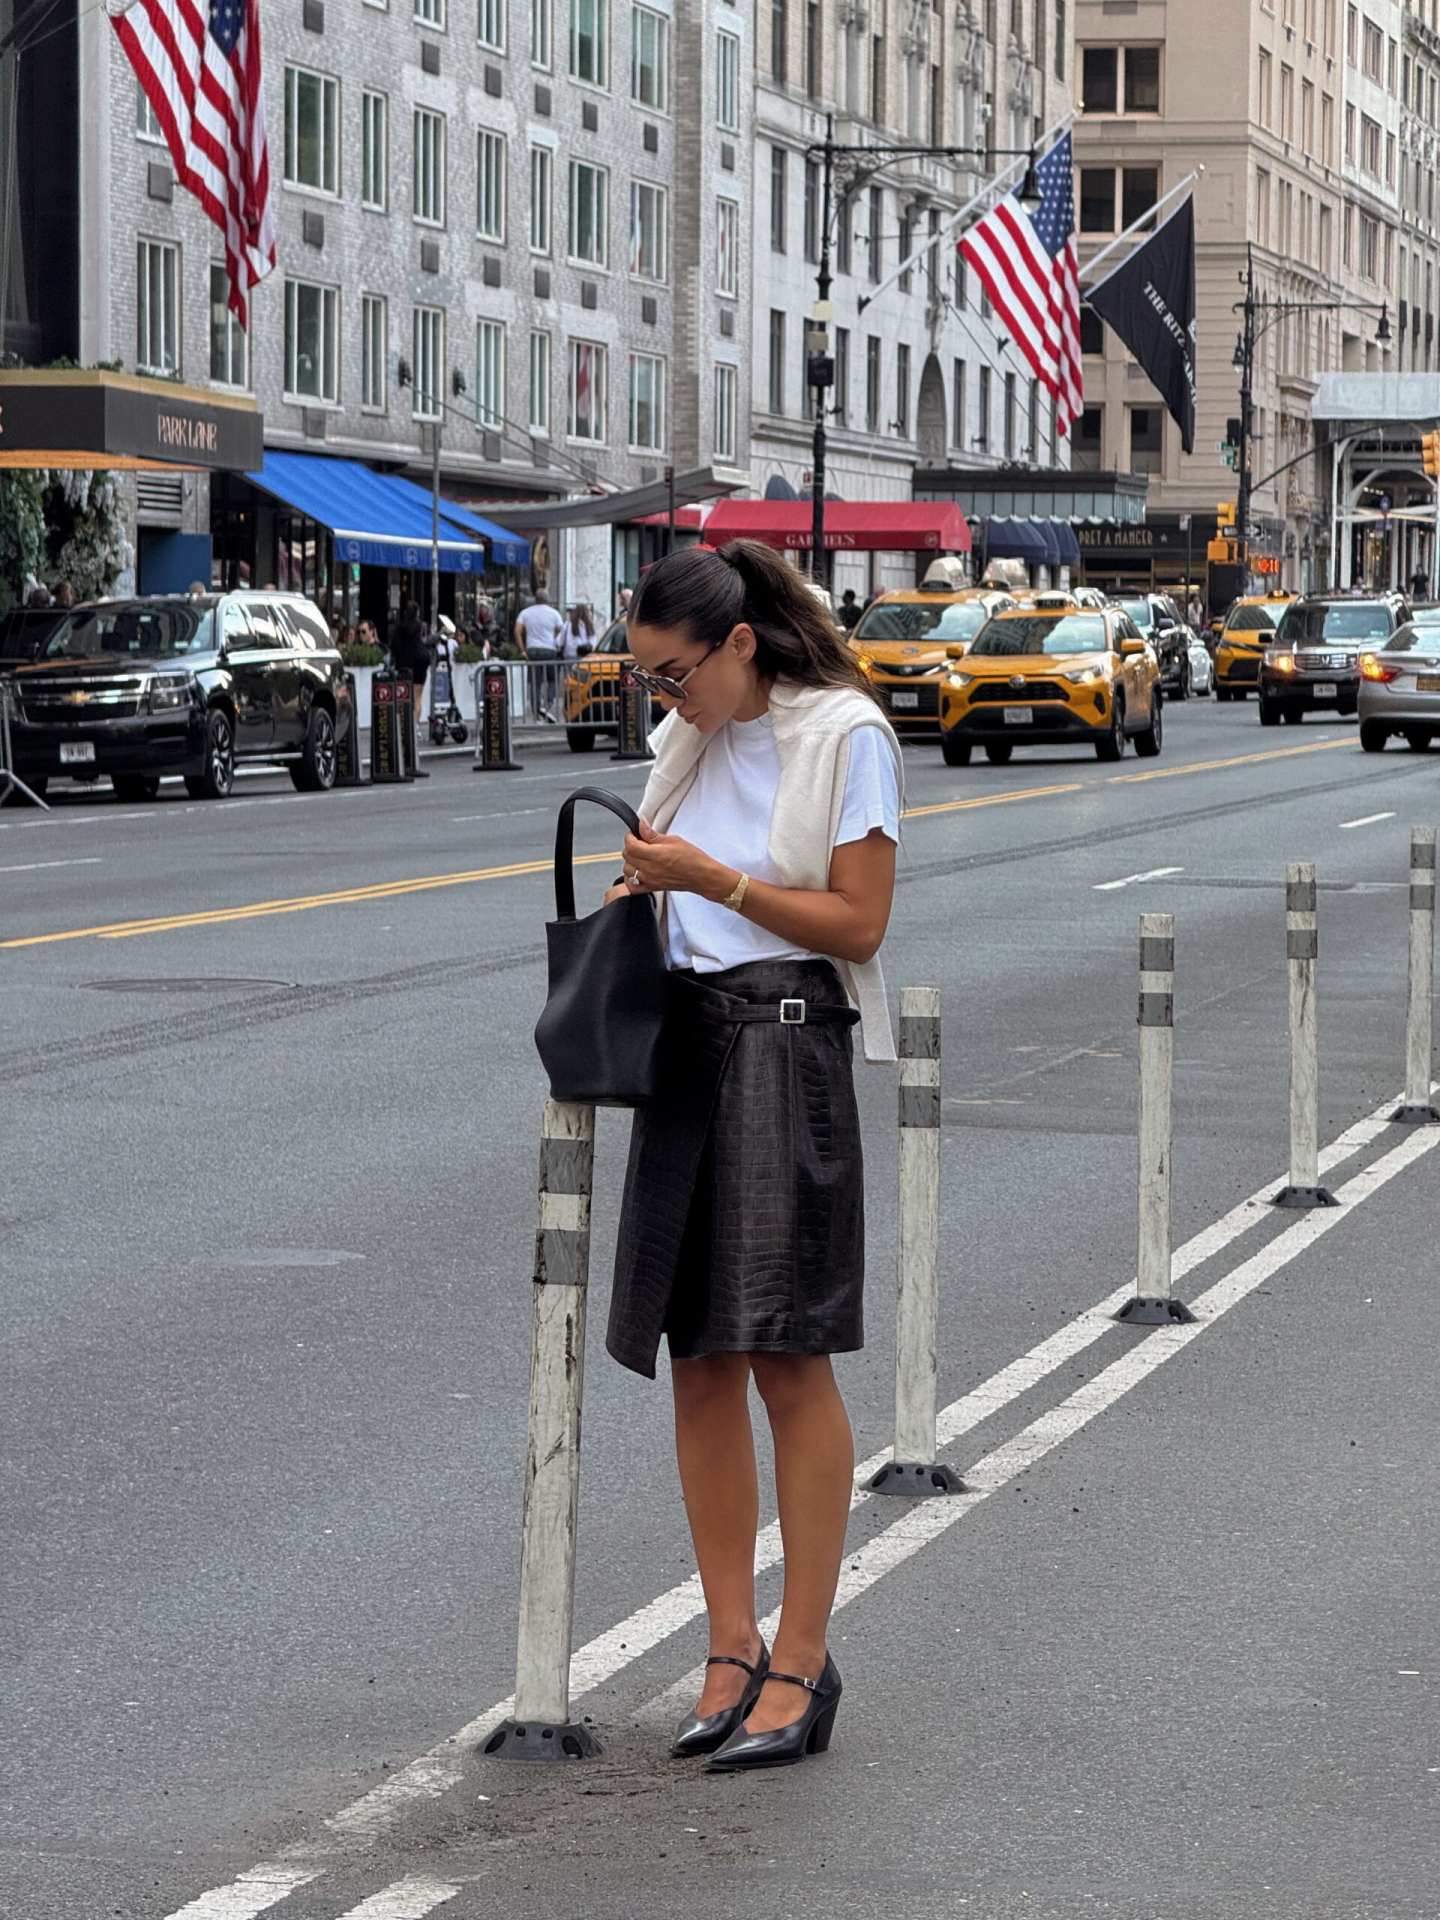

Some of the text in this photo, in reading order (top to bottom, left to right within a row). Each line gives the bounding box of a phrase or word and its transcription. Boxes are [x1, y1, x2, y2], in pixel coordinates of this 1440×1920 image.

[1143, 281, 1167, 315] THE
[158, 414, 217, 452] PARK LANE
[1078, 529, 1153, 545] PRET A MANGER
